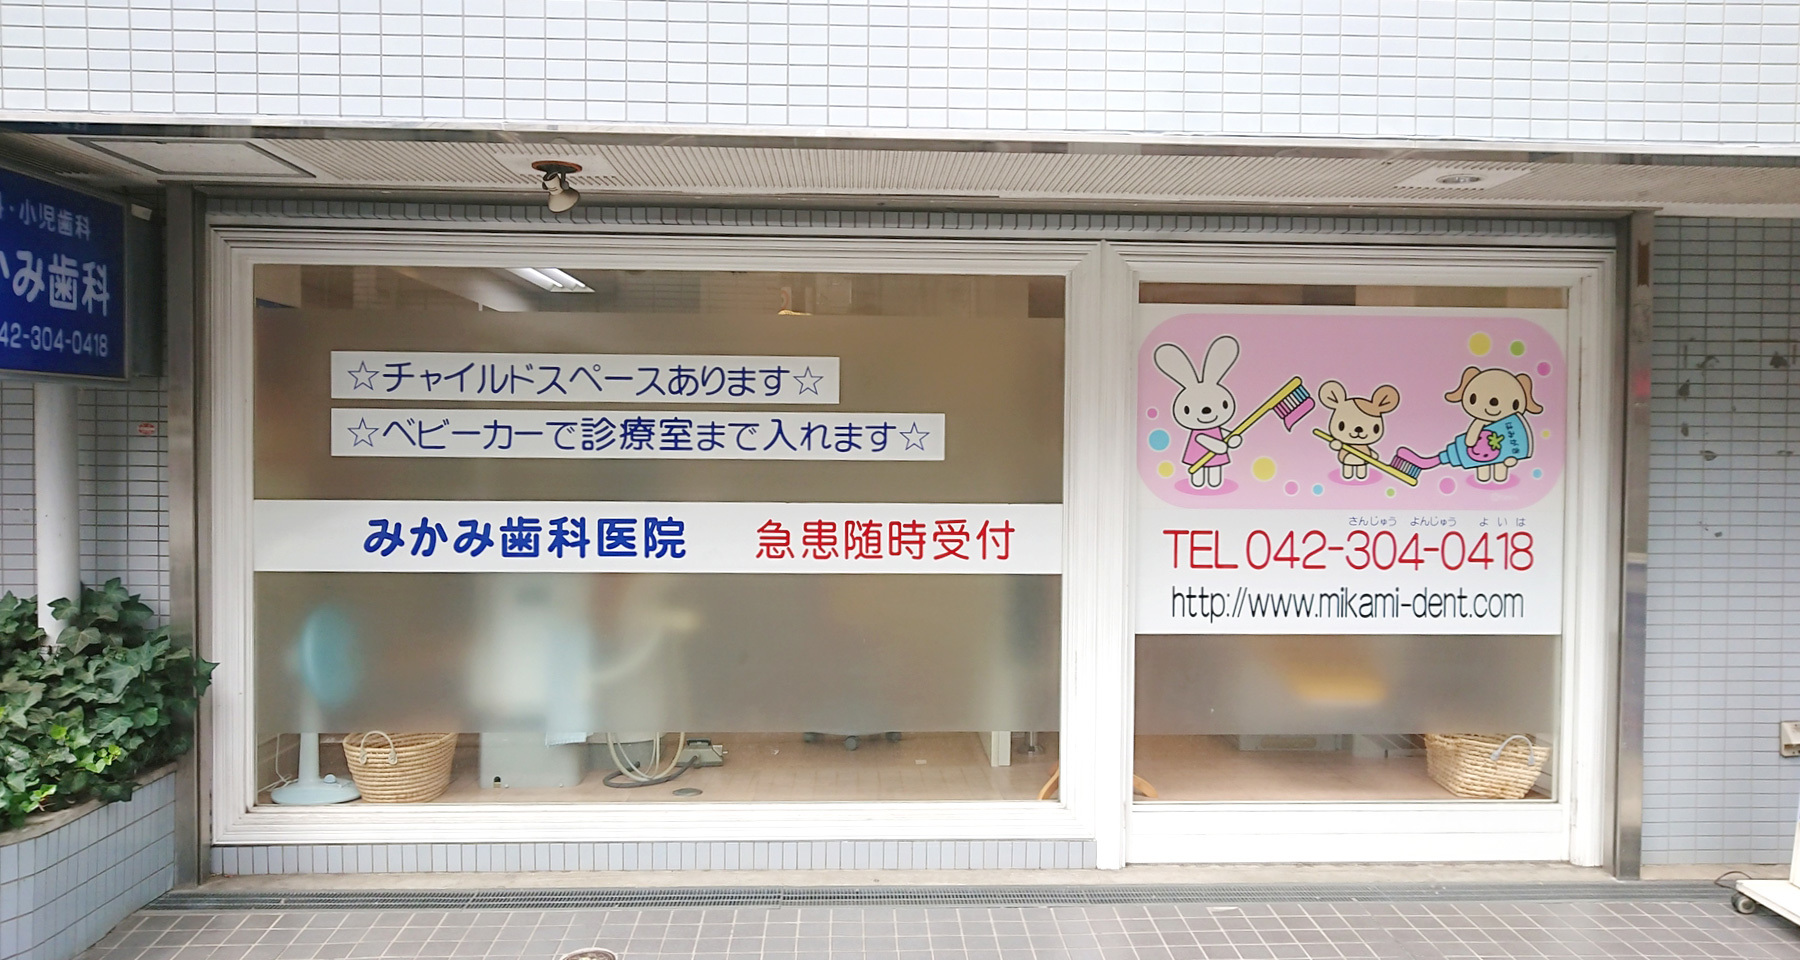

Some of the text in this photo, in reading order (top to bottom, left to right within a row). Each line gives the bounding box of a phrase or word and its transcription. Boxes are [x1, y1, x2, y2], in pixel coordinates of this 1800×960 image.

[363, 516, 1016, 560] みかみ歯科医院 急患随時受付
[1348, 516, 1397, 527] さんじゅう
[1410, 516, 1458, 527] よんじゅう
[1162, 529, 1534, 571] TEL 042-304-0418
[1171, 585, 1524, 624] http://www.mikami-dent.com
